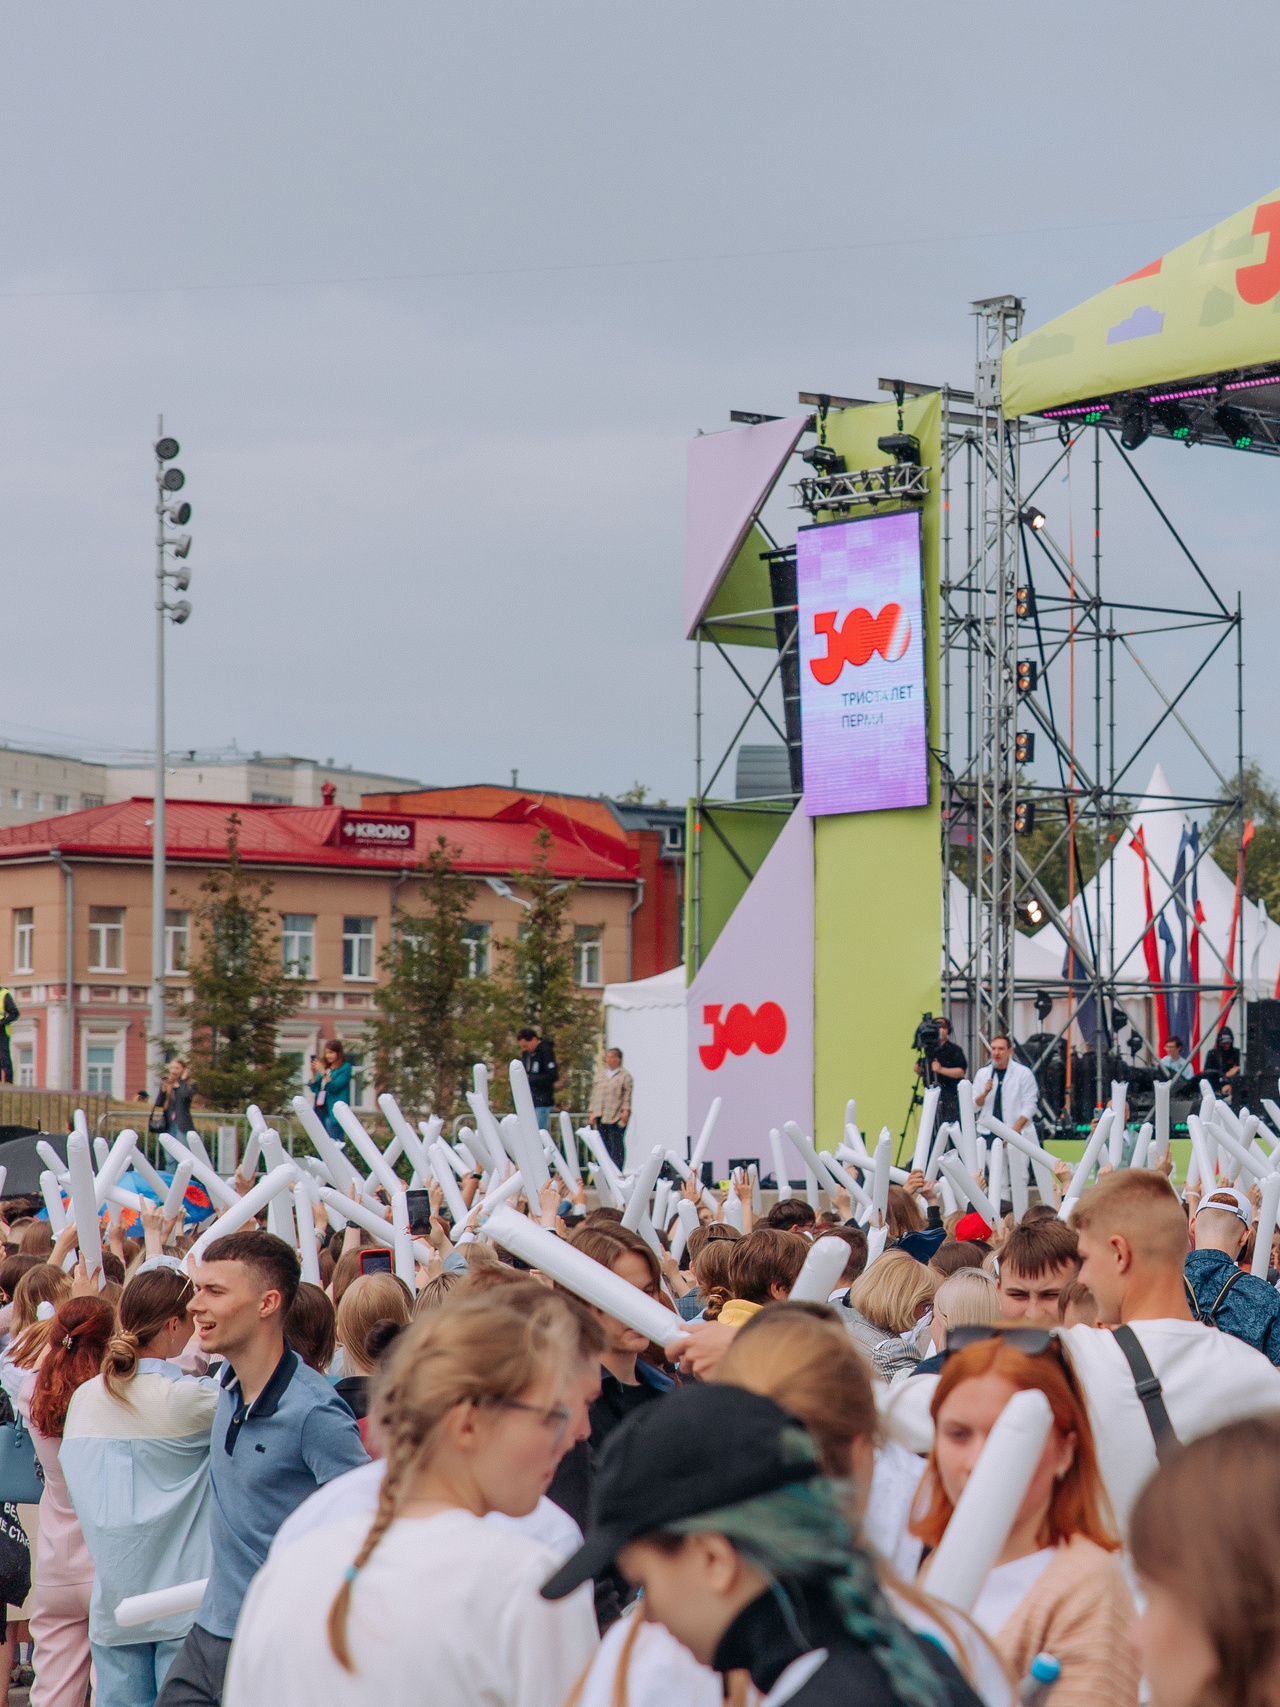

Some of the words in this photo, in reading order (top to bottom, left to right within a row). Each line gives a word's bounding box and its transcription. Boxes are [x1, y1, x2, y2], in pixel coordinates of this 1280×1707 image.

[809, 602, 911, 685] 300
[842, 690, 887, 707] ТРИСТА
[890, 686, 913, 701] ЛЕТ
[842, 713, 884, 728] ПЕРМИ
[355, 823, 411, 840] KRONO
[698, 1000, 788, 1072] 300
